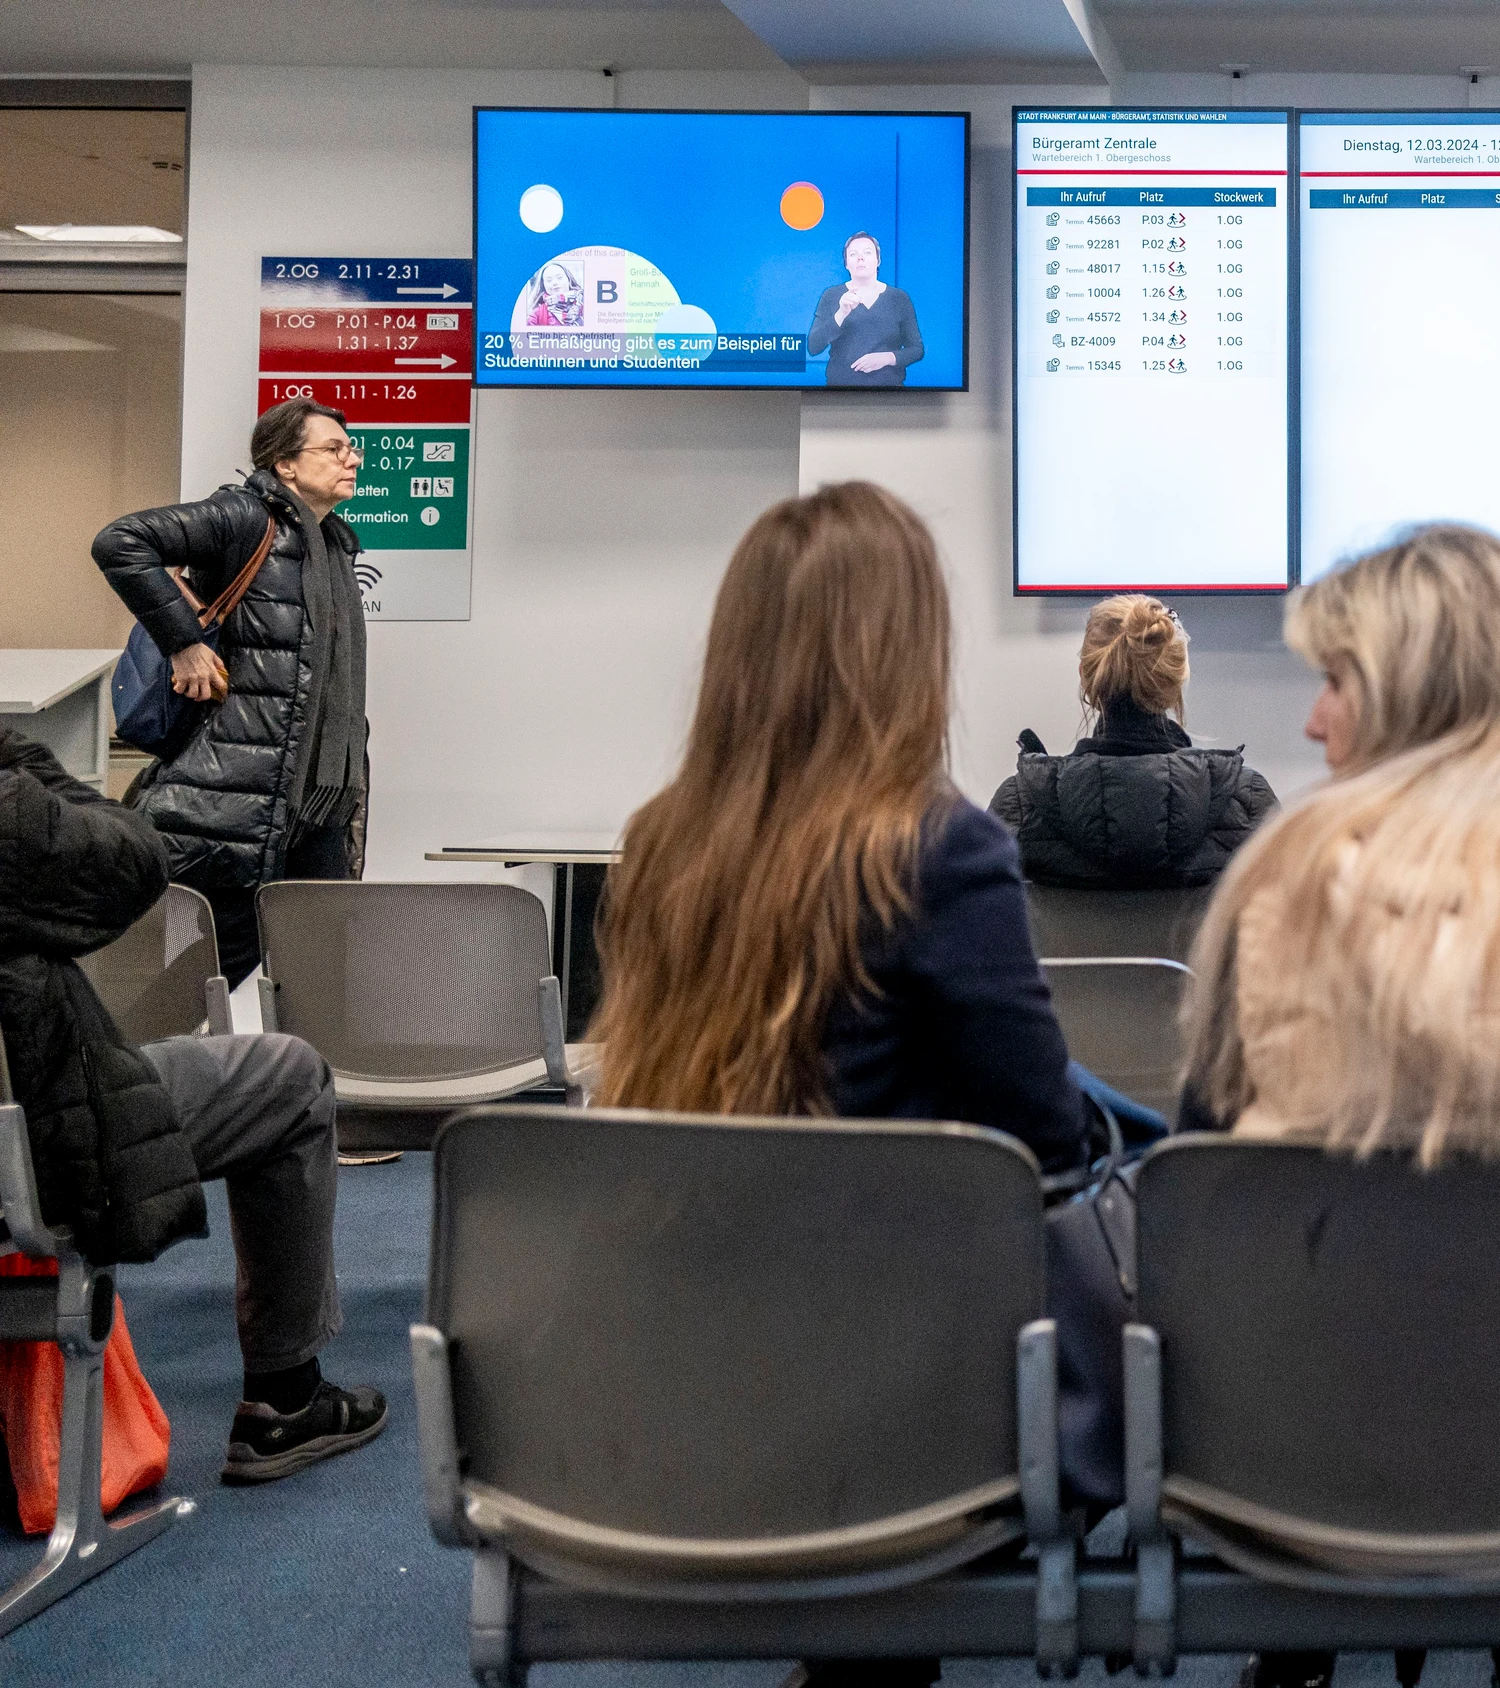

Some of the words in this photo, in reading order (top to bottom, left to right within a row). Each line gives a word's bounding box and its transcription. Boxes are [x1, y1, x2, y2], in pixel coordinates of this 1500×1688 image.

[1111, 112, 1151, 121] BÜRGERAMT,
[1032, 137, 1100, 151] Bürgeramt
[1104, 137, 1157, 149] Zentrale
[1343, 139, 1403, 153] Dienstag,
[1407, 139, 1479, 151] 12.03.2024
[1032, 153, 1093, 162] Wartebereich
[1096, 154, 1103, 162] 1.
[1106, 153, 1171, 163] Obergeschoss
[1414, 155, 1474, 164] Wartebereich
[1477, 155, 1484, 164] 1.
[1060, 192, 1073, 202] Ihr
[1075, 191, 1107, 202] Aufruf
[1139, 191, 1164, 202] Platz
[1214, 192, 1264, 202] Stockwerk
[1343, 194, 1356, 204] Ihr
[1358, 193, 1388, 204] Aufruf
[1421, 193, 1445, 204] Platz
[1086, 215, 1121, 225] 45663
[1142, 215, 1164, 225] P.03
[1217, 215, 1243, 225] 1.OG
[1086, 239, 1121, 250] 92281
[1142, 239, 1164, 250] P.02
[1217, 239, 1243, 250] 1.OG
[276, 264, 319, 278] 2.OG
[338, 264, 371, 279] 2.11
[387, 265, 419, 279] 2.31
[1086, 263, 1121, 274] 48017
[1142, 263, 1166, 274] 1.15
[1217, 263, 1243, 274] 1.OG
[630, 280, 660, 288] Hannah
[596, 280, 619, 304] B
[1086, 287, 1121, 298] 10004
[1142, 287, 1166, 298] 1.26
[1217, 287, 1243, 298] 1.OG
[275, 314, 315, 329] 1.OG
[336, 315, 367, 329] P.01
[383, 315, 416, 329] P.04
[1086, 311, 1121, 322] 45572
[1142, 311, 1166, 322] 1.34
[1217, 311, 1243, 322] 1.OG
[337, 336, 367, 350] 1.31
[385, 336, 419, 350] 1.37
[484, 335, 504, 349] 20
[509, 335, 523, 349] %
[529, 335, 620, 352] Ermäßigung
[625, 335, 654, 353] gibt
[657, 338, 676, 350] es
[680, 339, 713, 350] zum
[717, 336, 776, 353] Beispiel
[781, 336, 801, 350] für
[1070, 336, 1116, 346] BZ-4009
[1142, 336, 1164, 346] P.04
[1217, 336, 1243, 346] 1.OG
[484, 353, 585, 368] Studentinnen
[590, 354, 618, 368] und
[622, 354, 700, 369] Studenten
[1086, 360, 1121, 371] 15345
[1142, 360, 1166, 371] 1.25
[1217, 360, 1243, 371] 1.OG
[273, 385, 314, 399] 1.OG
[335, 385, 366, 399] 1.11
[384, 385, 417, 400] 1.26
[380, 436, 415, 450] 0.04
[380, 457, 415, 471] 0.17
[332, 508, 409, 523] nformation
